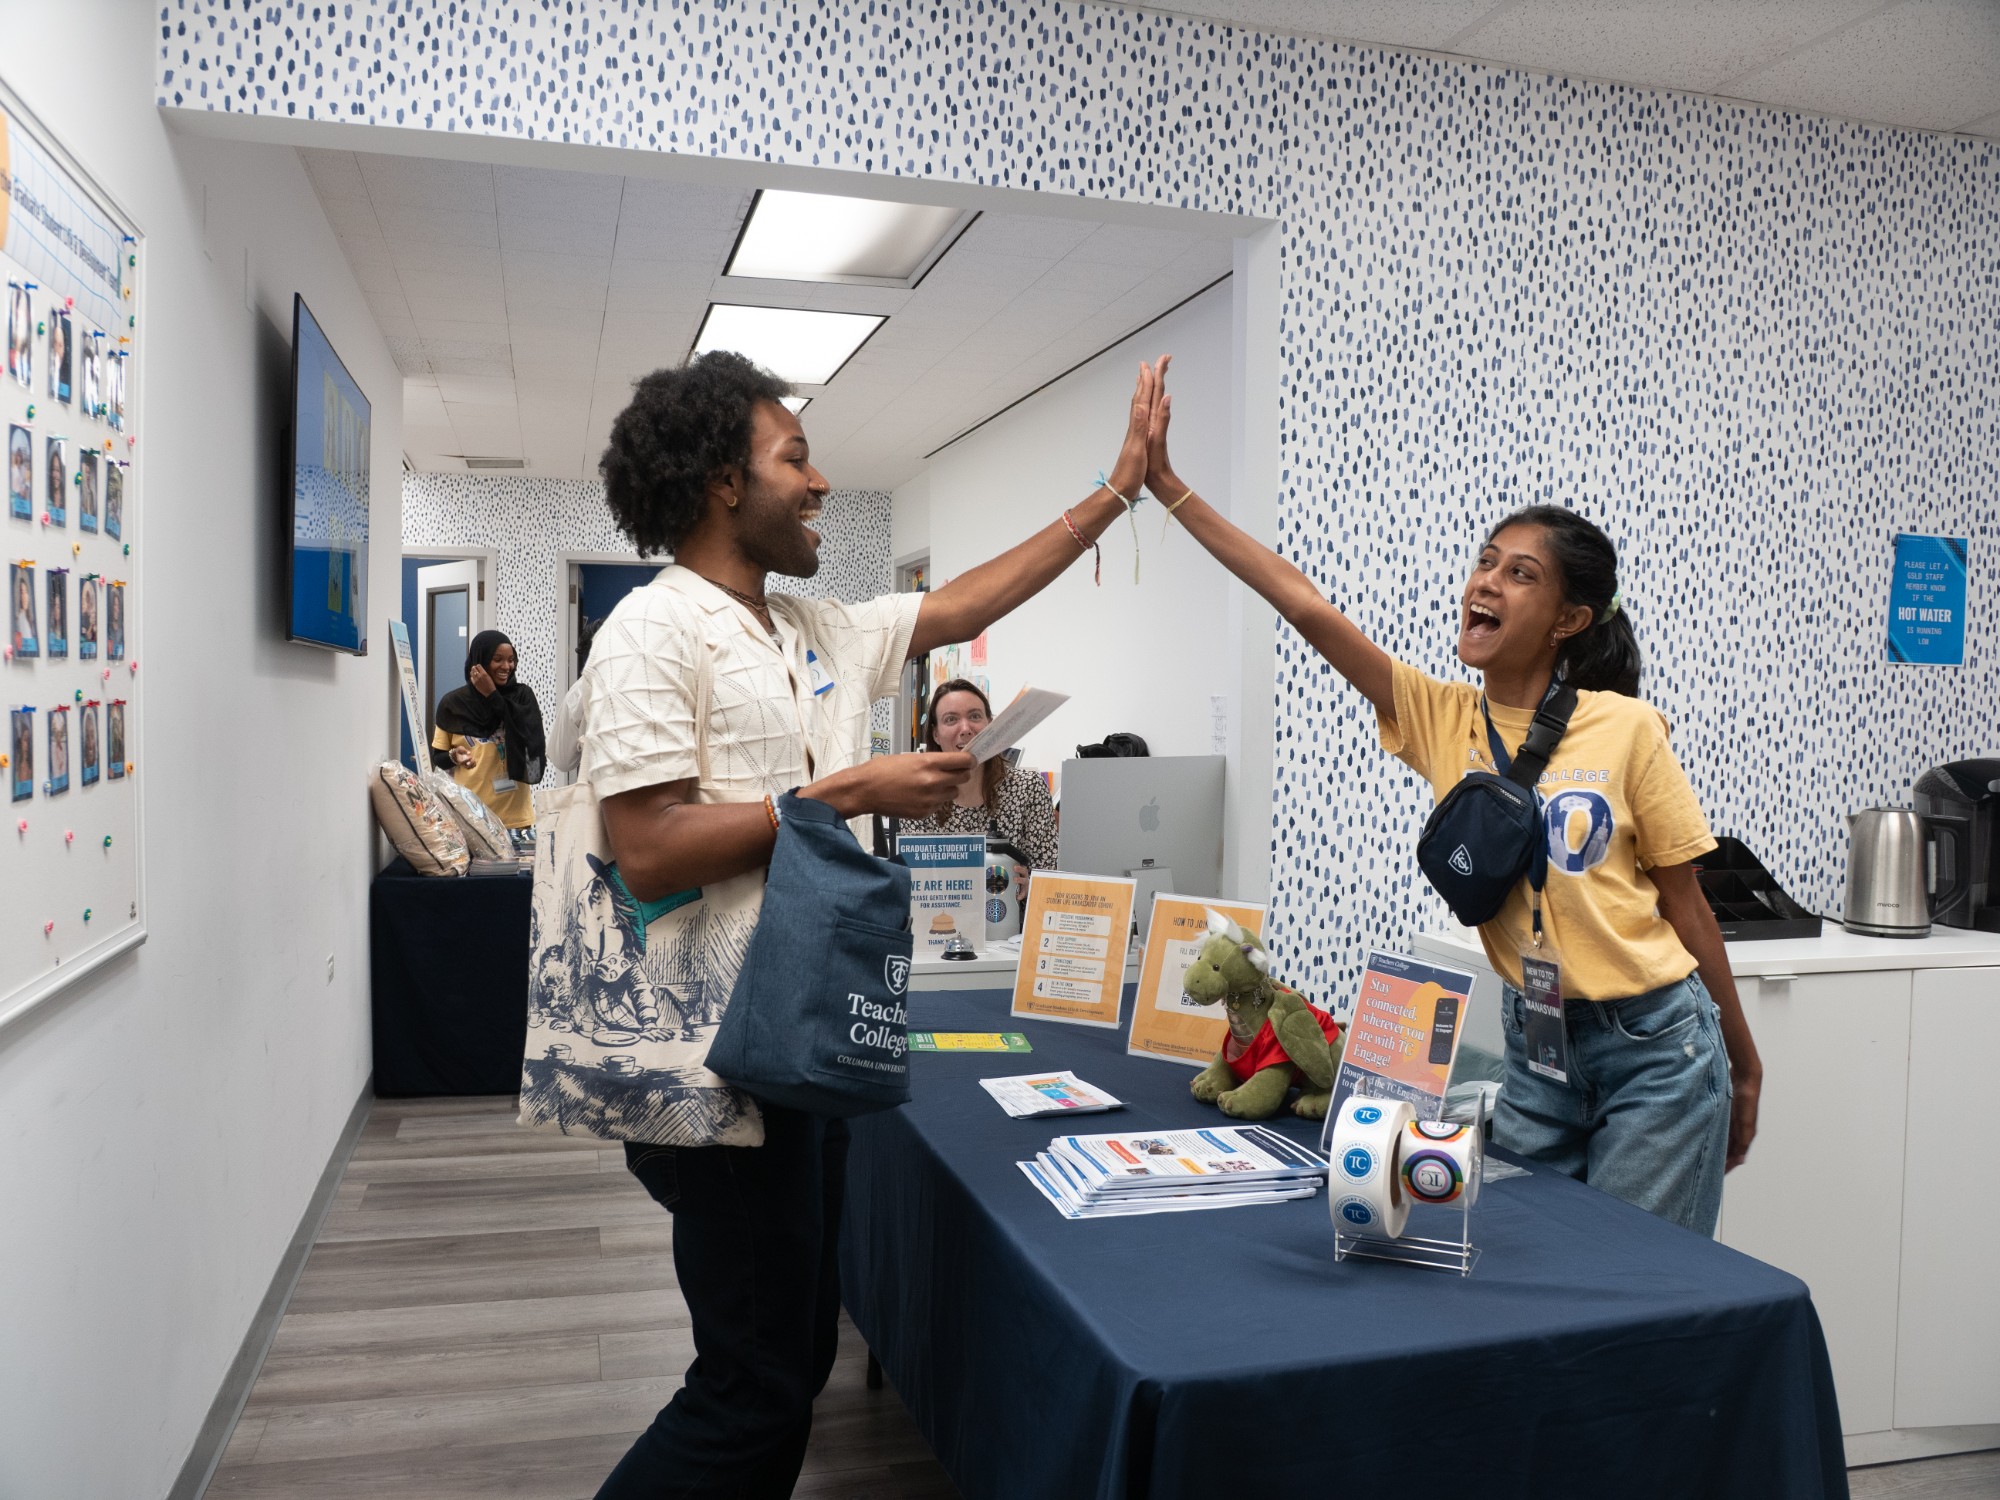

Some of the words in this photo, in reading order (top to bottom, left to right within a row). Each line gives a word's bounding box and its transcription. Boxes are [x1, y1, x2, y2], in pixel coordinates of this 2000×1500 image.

[1904, 561, 1926, 569] PLEASE
[1926, 573, 1944, 581] STAFF
[1905, 583, 1927, 591] MEMBER
[1930, 584, 1946, 592] KNOW
[1923, 594, 1934, 602] THE
[1898, 606, 1917, 621] HOT
[1919, 607, 1952, 623] WATER
[1907, 626, 1914, 634] IS
[1916, 627, 1942, 635] RUNNING
[1918, 638, 1930, 646] LOW
[1540, 769, 1609, 784] OLLEGE
[900, 844, 937, 853] GRADUATE
[938, 844, 968, 852] STUDENT
[969, 843, 983, 852] LIFE
[921, 852, 969, 861] DEVELOPMENT
[924, 880, 943, 891] ARE
[945, 879, 973, 891] HERE!
[911, 894, 929, 902] PLEASE
[1048, 916, 1052, 925] 1
[1173, 917, 1186, 927] HOW
[1187, 918, 1195, 928] TO
[1043, 937, 1049, 948] 2
[1040, 959, 1046, 969] 3
[1526, 966, 1537, 977] NEW
[1538, 969, 1545, 978] TO
[1037, 982, 1043, 992] 4
[1369, 977, 1392, 997] Stay
[1532, 978, 1542, 988] ASK
[847, 992, 908, 1025] Teache
[1366, 996, 1418, 1021] connected,
[1362, 1012, 1406, 1035] wherever
[1406, 1027, 1425, 1042] you
[1357, 1030, 1373, 1043] are
[1375, 1031, 1396, 1051] with
[1398, 1039, 1414, 1057] TC
[1353, 1043, 1392, 1068] Engage!
[837, 1054, 874, 1070] COLUMBIA
[1341, 1078, 1350, 1088] to
[1374, 1077, 1385, 1090] the
[1386, 1082, 1397, 1095] TC
[1360, 1109, 1378, 1120] TC
[1349, 1155, 1367, 1170] TC
[1421, 1172, 1443, 1187] TC
[1347, 1208, 1366, 1220] TC
